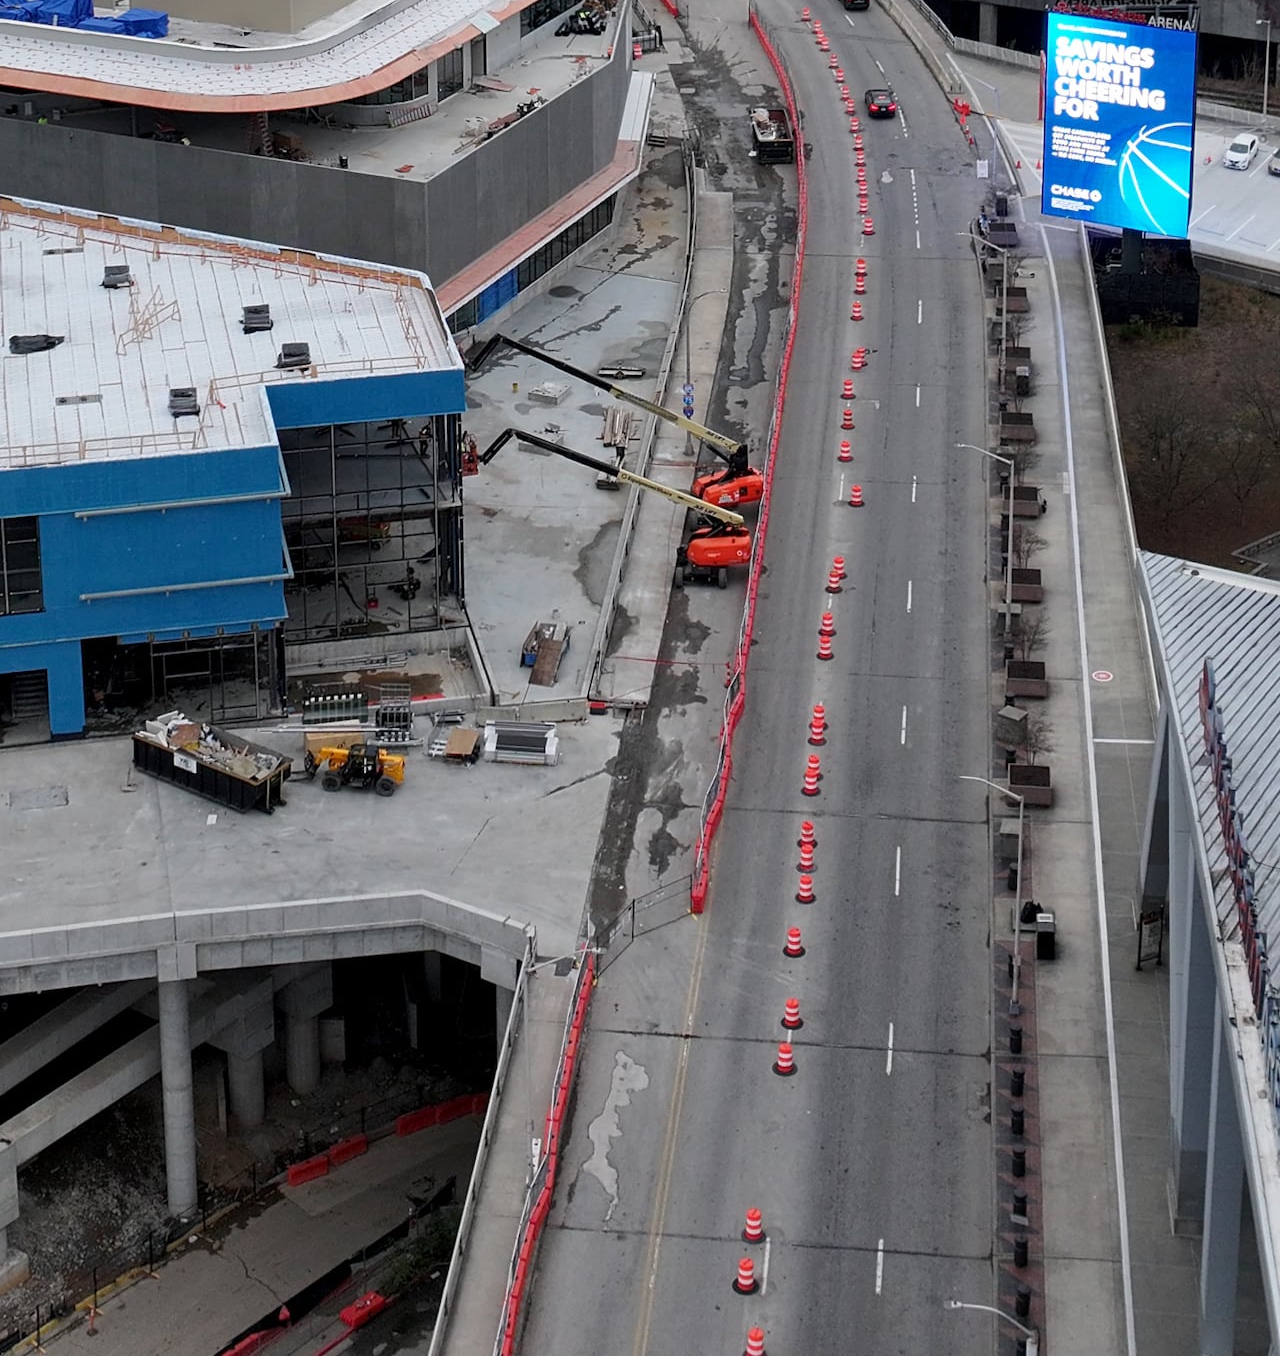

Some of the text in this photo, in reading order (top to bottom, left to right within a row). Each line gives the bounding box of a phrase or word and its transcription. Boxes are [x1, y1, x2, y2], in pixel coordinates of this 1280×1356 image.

[1147, 15, 1193, 32] ARENA
[1055, 36, 1155, 69] SAVINGS
[1055, 56, 1141, 87] WORTH
[1054, 76, 1166, 111] CHEERING
[1053, 97, 1099, 121] FOR
[1050, 184, 1090, 201] CHASE
